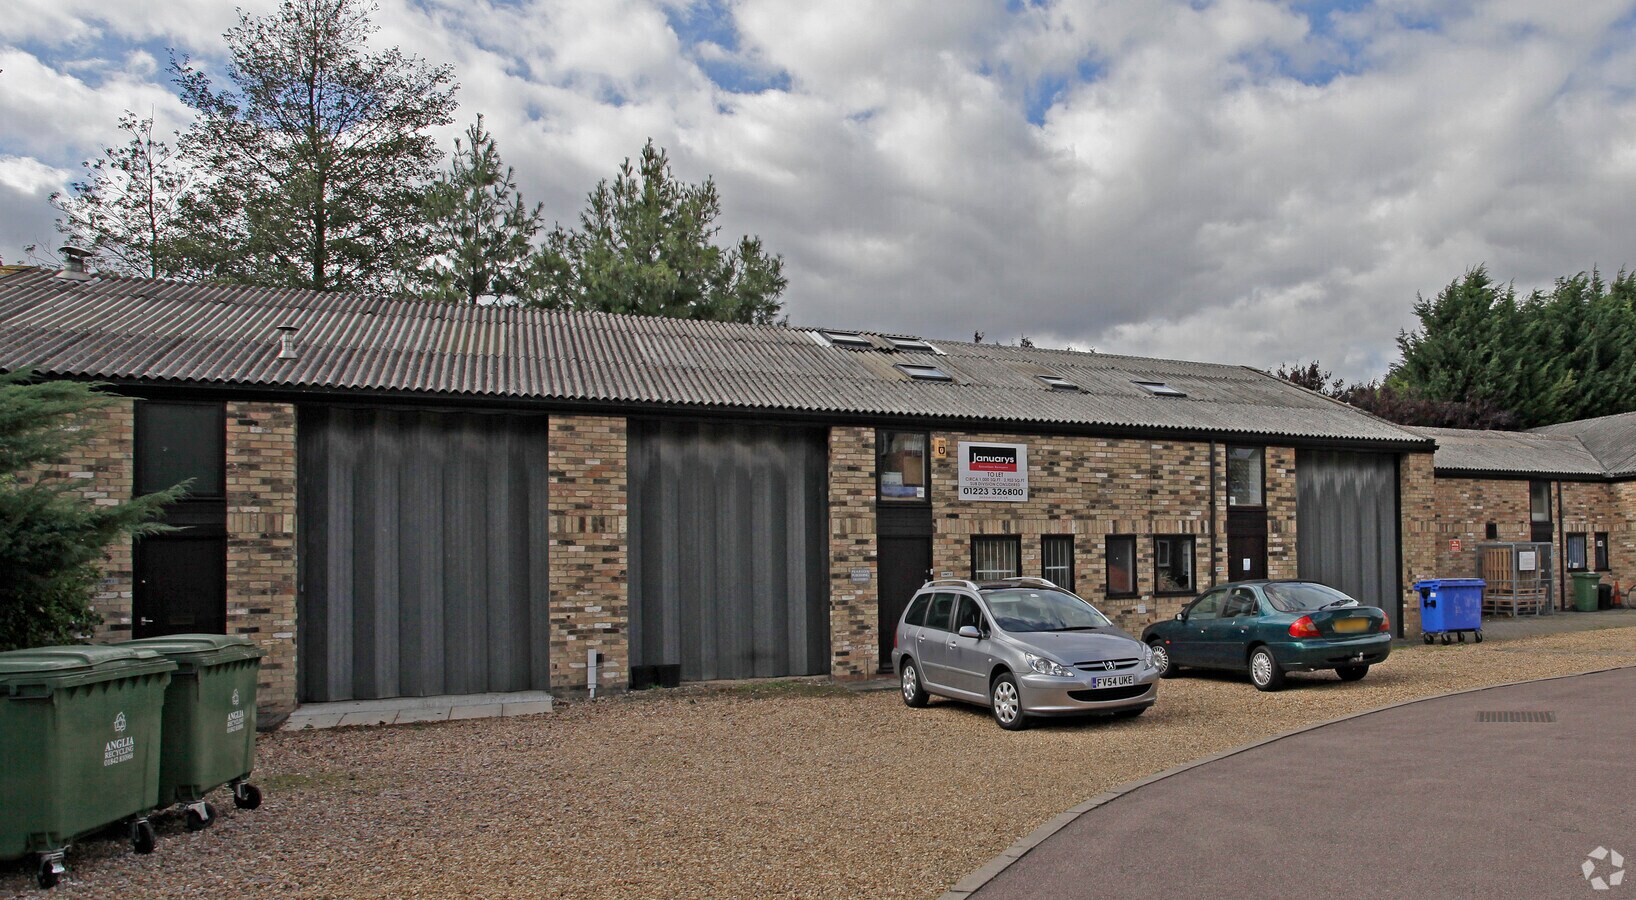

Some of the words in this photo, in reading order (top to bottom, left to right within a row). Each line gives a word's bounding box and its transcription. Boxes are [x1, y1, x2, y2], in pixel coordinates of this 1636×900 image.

[972, 452, 1014, 464] Januarys
[1097, 677, 1117, 687] FV54
[1119, 676, 1132, 685] UKE
[105, 736, 134, 752] ANGLIA
[105, 746, 134, 759] RECYCLING
